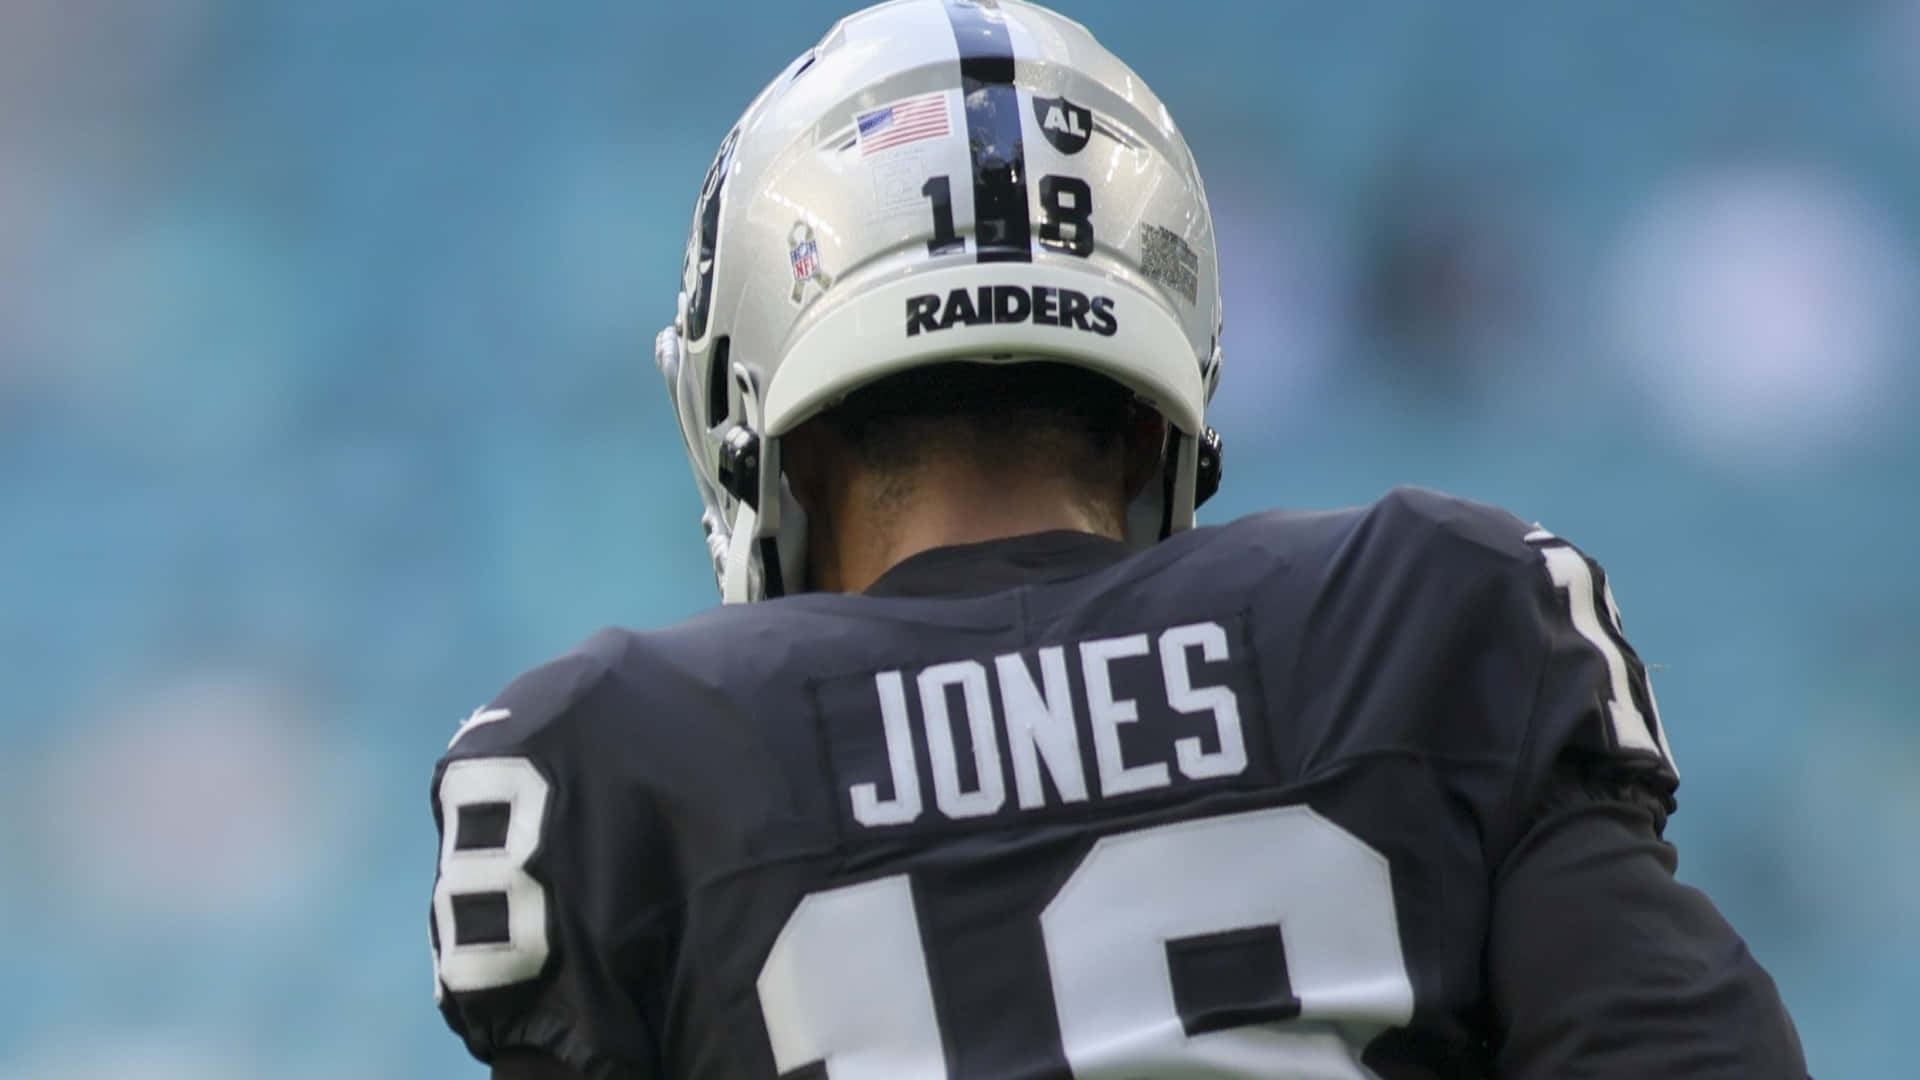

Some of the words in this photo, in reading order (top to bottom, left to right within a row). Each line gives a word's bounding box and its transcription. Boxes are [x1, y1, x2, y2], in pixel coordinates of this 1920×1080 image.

[1043, 106, 1087, 139] AL
[795, 256, 819, 279] NFL
[906, 285, 1118, 337] RAIDERS
[850, 622, 1248, 827] JONES
